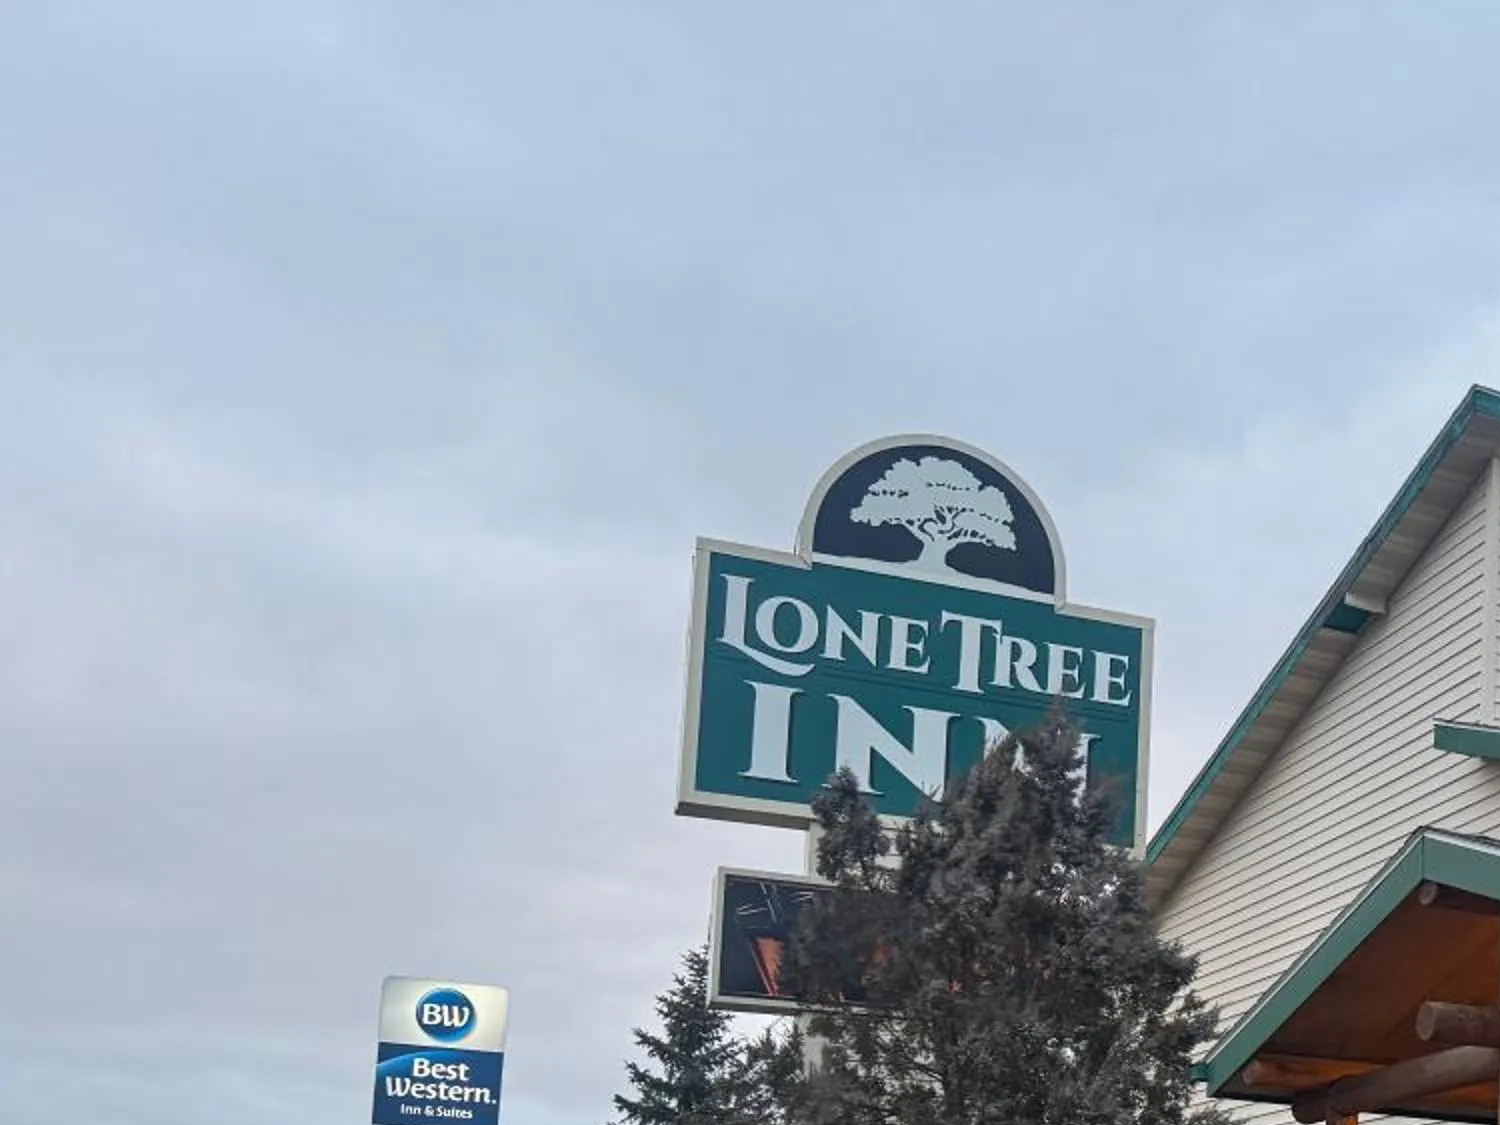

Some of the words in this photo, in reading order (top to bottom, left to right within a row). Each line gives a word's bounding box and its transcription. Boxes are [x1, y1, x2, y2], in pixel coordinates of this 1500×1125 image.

[717, 573, 931, 677] LONE
[940, 610, 1132, 706] TREE
[422, 1003, 470, 1028] BW
[412, 1057, 470, 1082] Best
[400, 1103, 421, 1115] Inn
[425, 1105, 435, 1117] &
[436, 1106, 473, 1119] Suites
